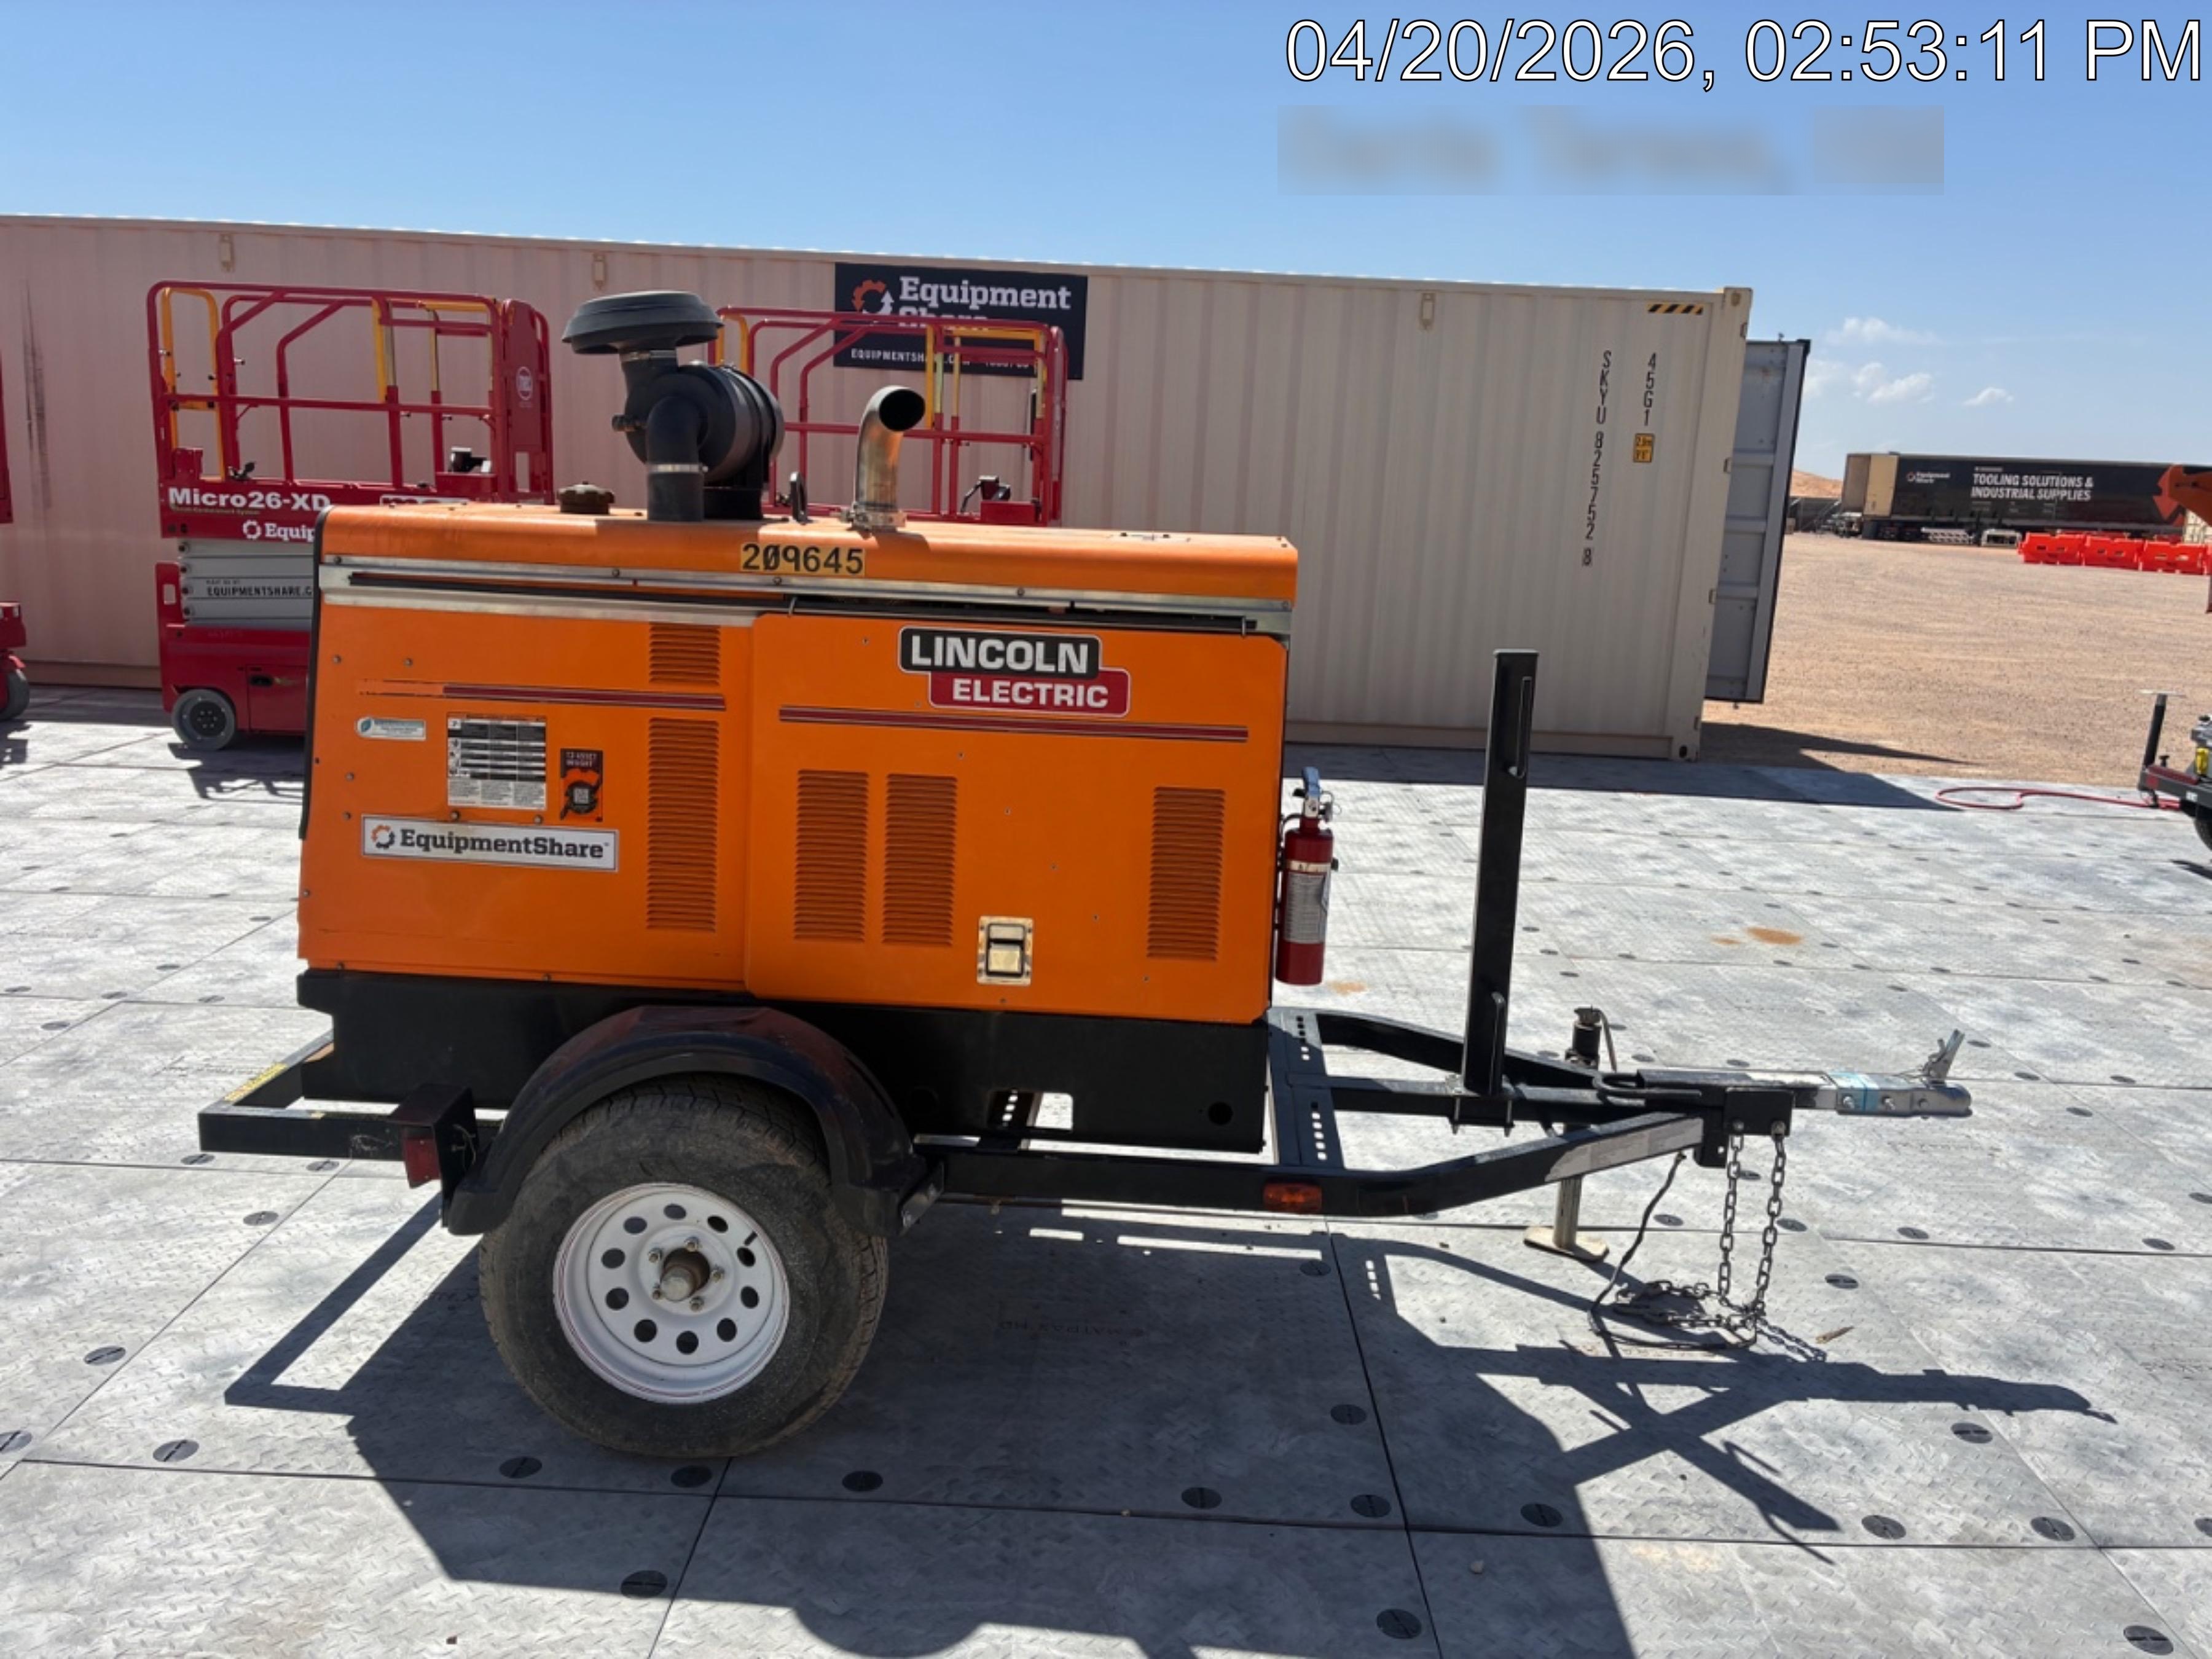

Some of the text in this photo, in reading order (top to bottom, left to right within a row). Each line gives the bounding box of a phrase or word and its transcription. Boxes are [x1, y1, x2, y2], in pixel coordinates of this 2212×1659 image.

[900, 277, 1071, 310] Equipment
[1643, 353, 1657, 426] 45G1
[1971, 486, 2092, 501] INDUSTRIAL SUPPLIES
[1973, 473, 2020, 486] TOOLING
[2022, 474, 2082, 487] SOLUTIONS
[168, 488, 331, 511] Micro26-XD
[742, 543, 863, 574] 209645
[911, 634, 1088, 673] LINCOLN
[952, 677, 1108, 708] ELECTRIC
[400, 829, 604, 858] EquipmentShare
